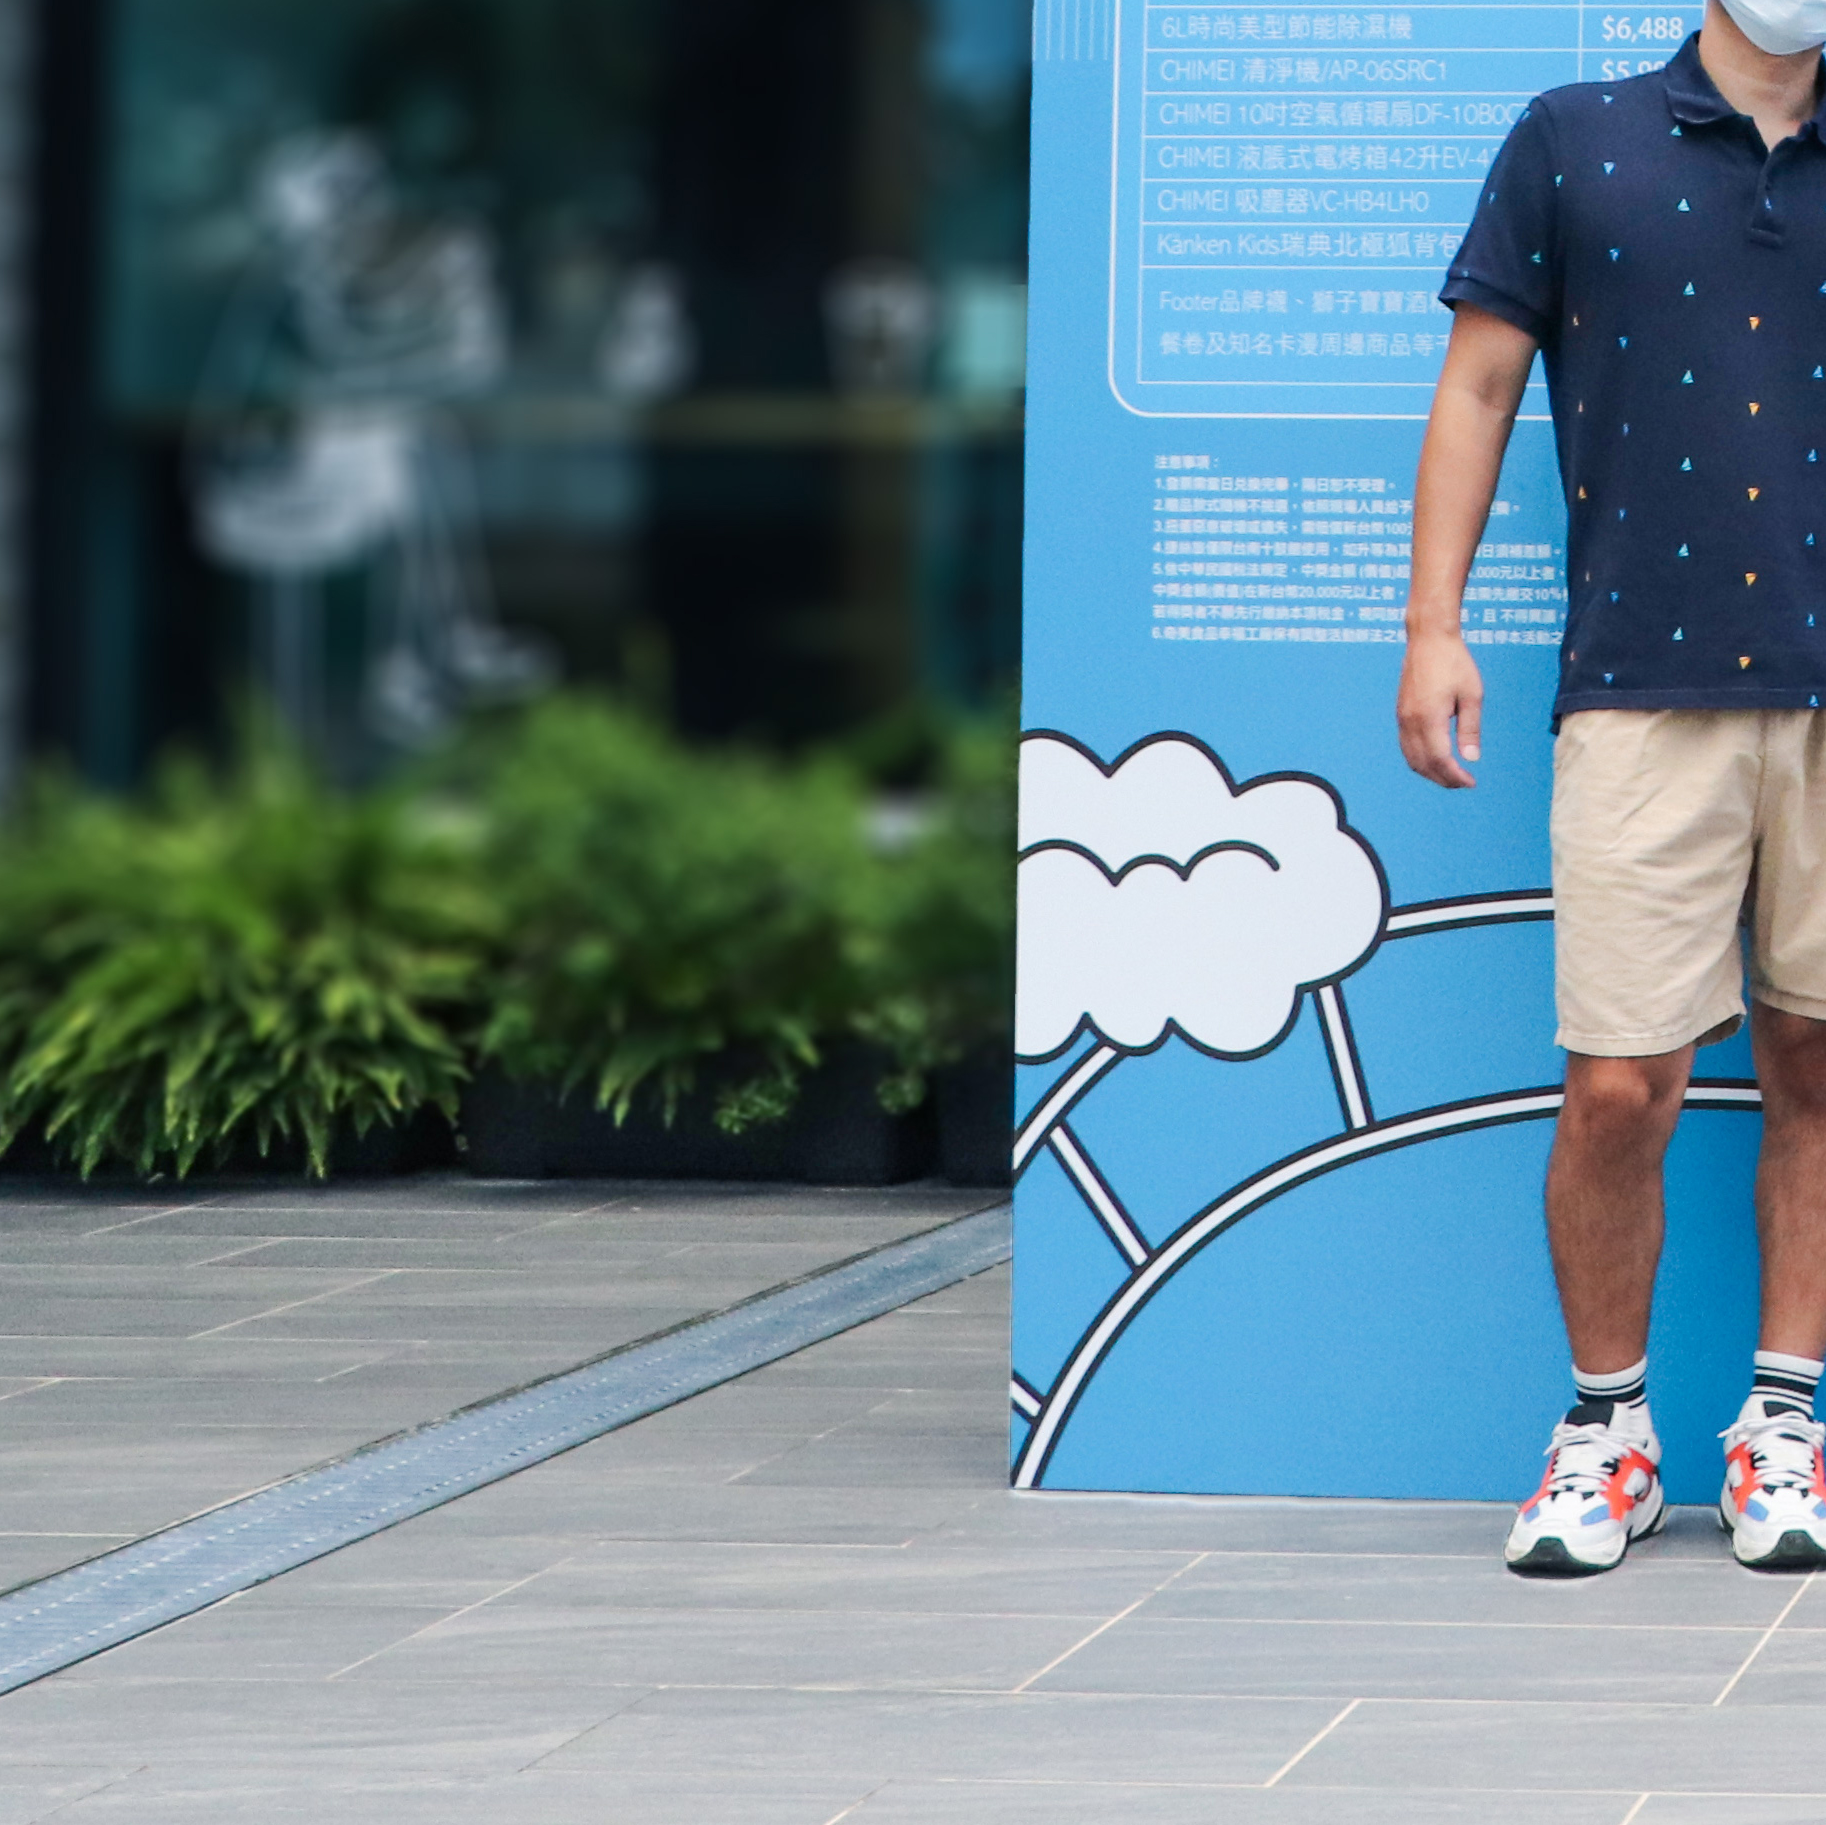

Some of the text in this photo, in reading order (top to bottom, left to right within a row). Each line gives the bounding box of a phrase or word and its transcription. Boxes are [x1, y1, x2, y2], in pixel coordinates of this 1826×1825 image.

[1602, 15, 1684, 42] $6,488
[1160, 58, 1235, 82] CHIMEI
[1159, 102, 1231, 125] CHIMEI
[1158, 145, 1230, 169] CHIMEI
[1157, 189, 1229, 212] CHIMEI
